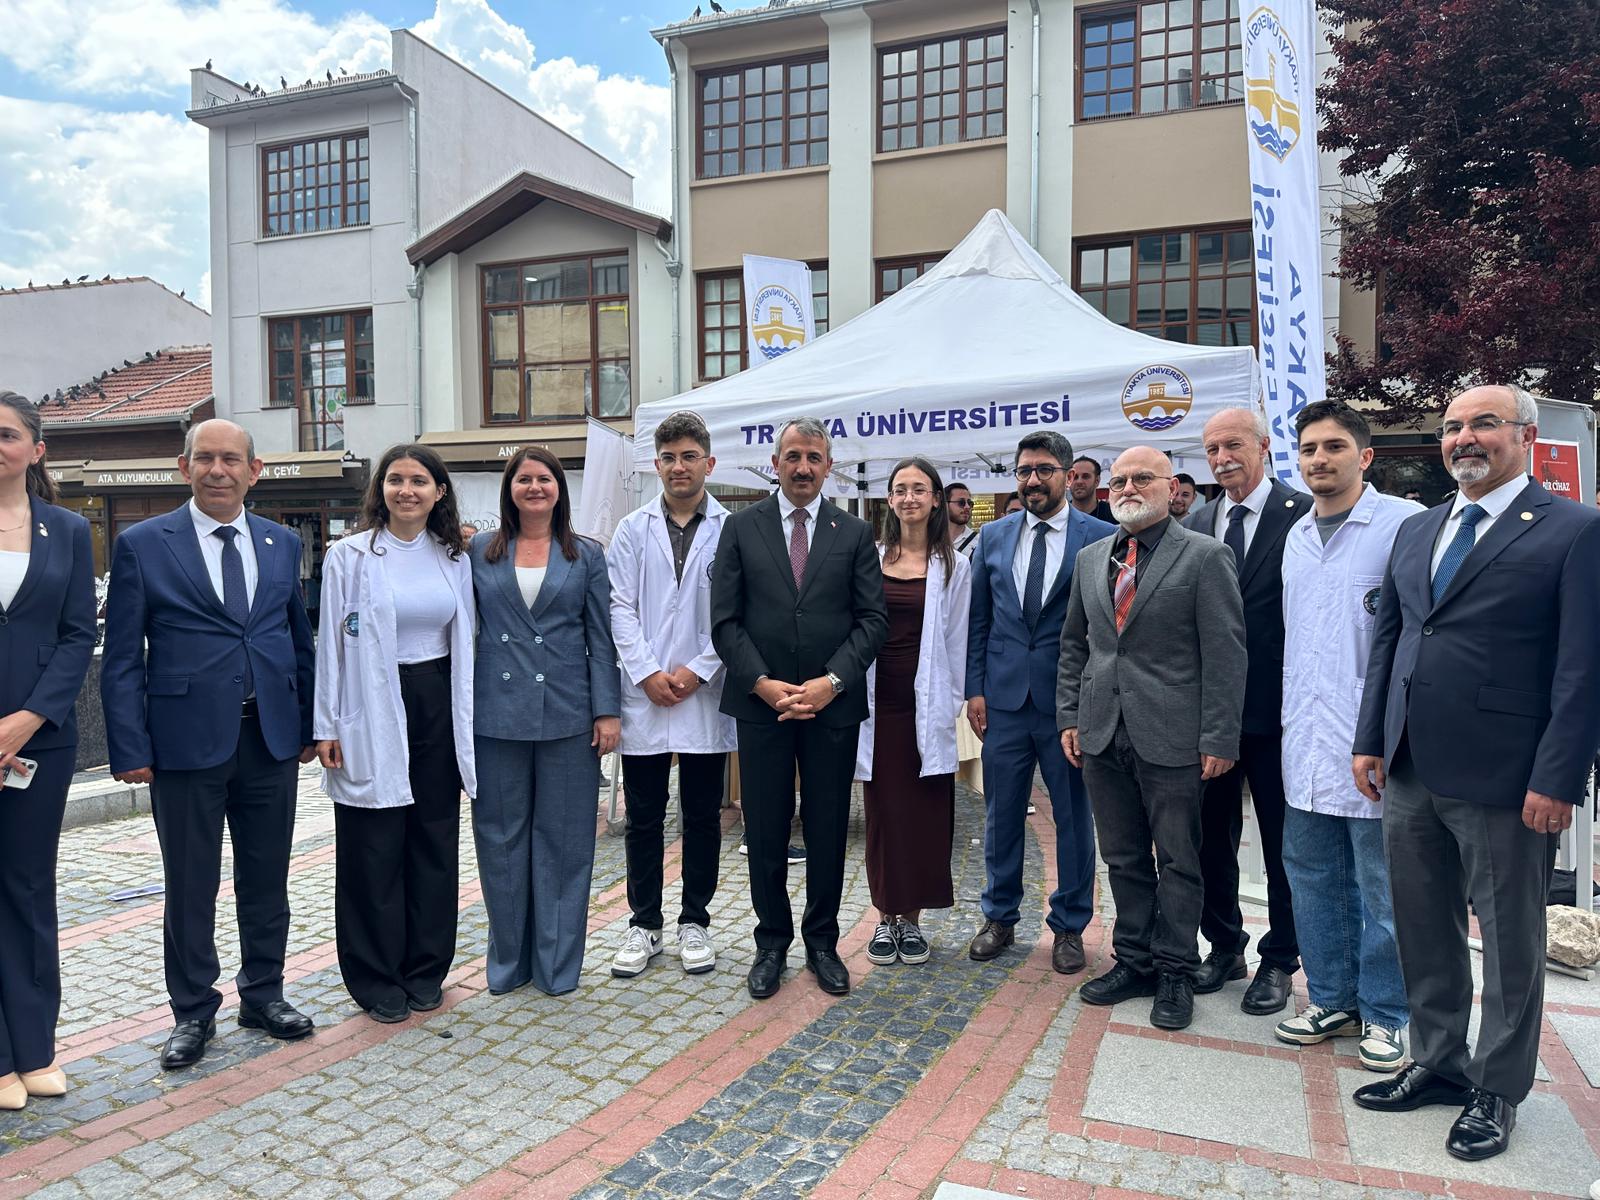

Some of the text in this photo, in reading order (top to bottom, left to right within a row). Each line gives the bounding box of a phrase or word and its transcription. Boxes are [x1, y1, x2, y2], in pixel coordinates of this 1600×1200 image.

[1124, 366, 1190, 399] TRAKYA ÜNİVERSİTESİ
[1149, 387, 1164, 396] 1982
[740, 418, 848, 445] TRA
[857, 394, 1071, 437] ÜNİVERSİTESİ
[98, 472, 173, 483] ATA KUYUMCULUK
[273, 464, 301, 479] ÇEYİZ
[1552, 479, 1571, 491] CİHAZ
[464, 519, 497, 531] ODA
